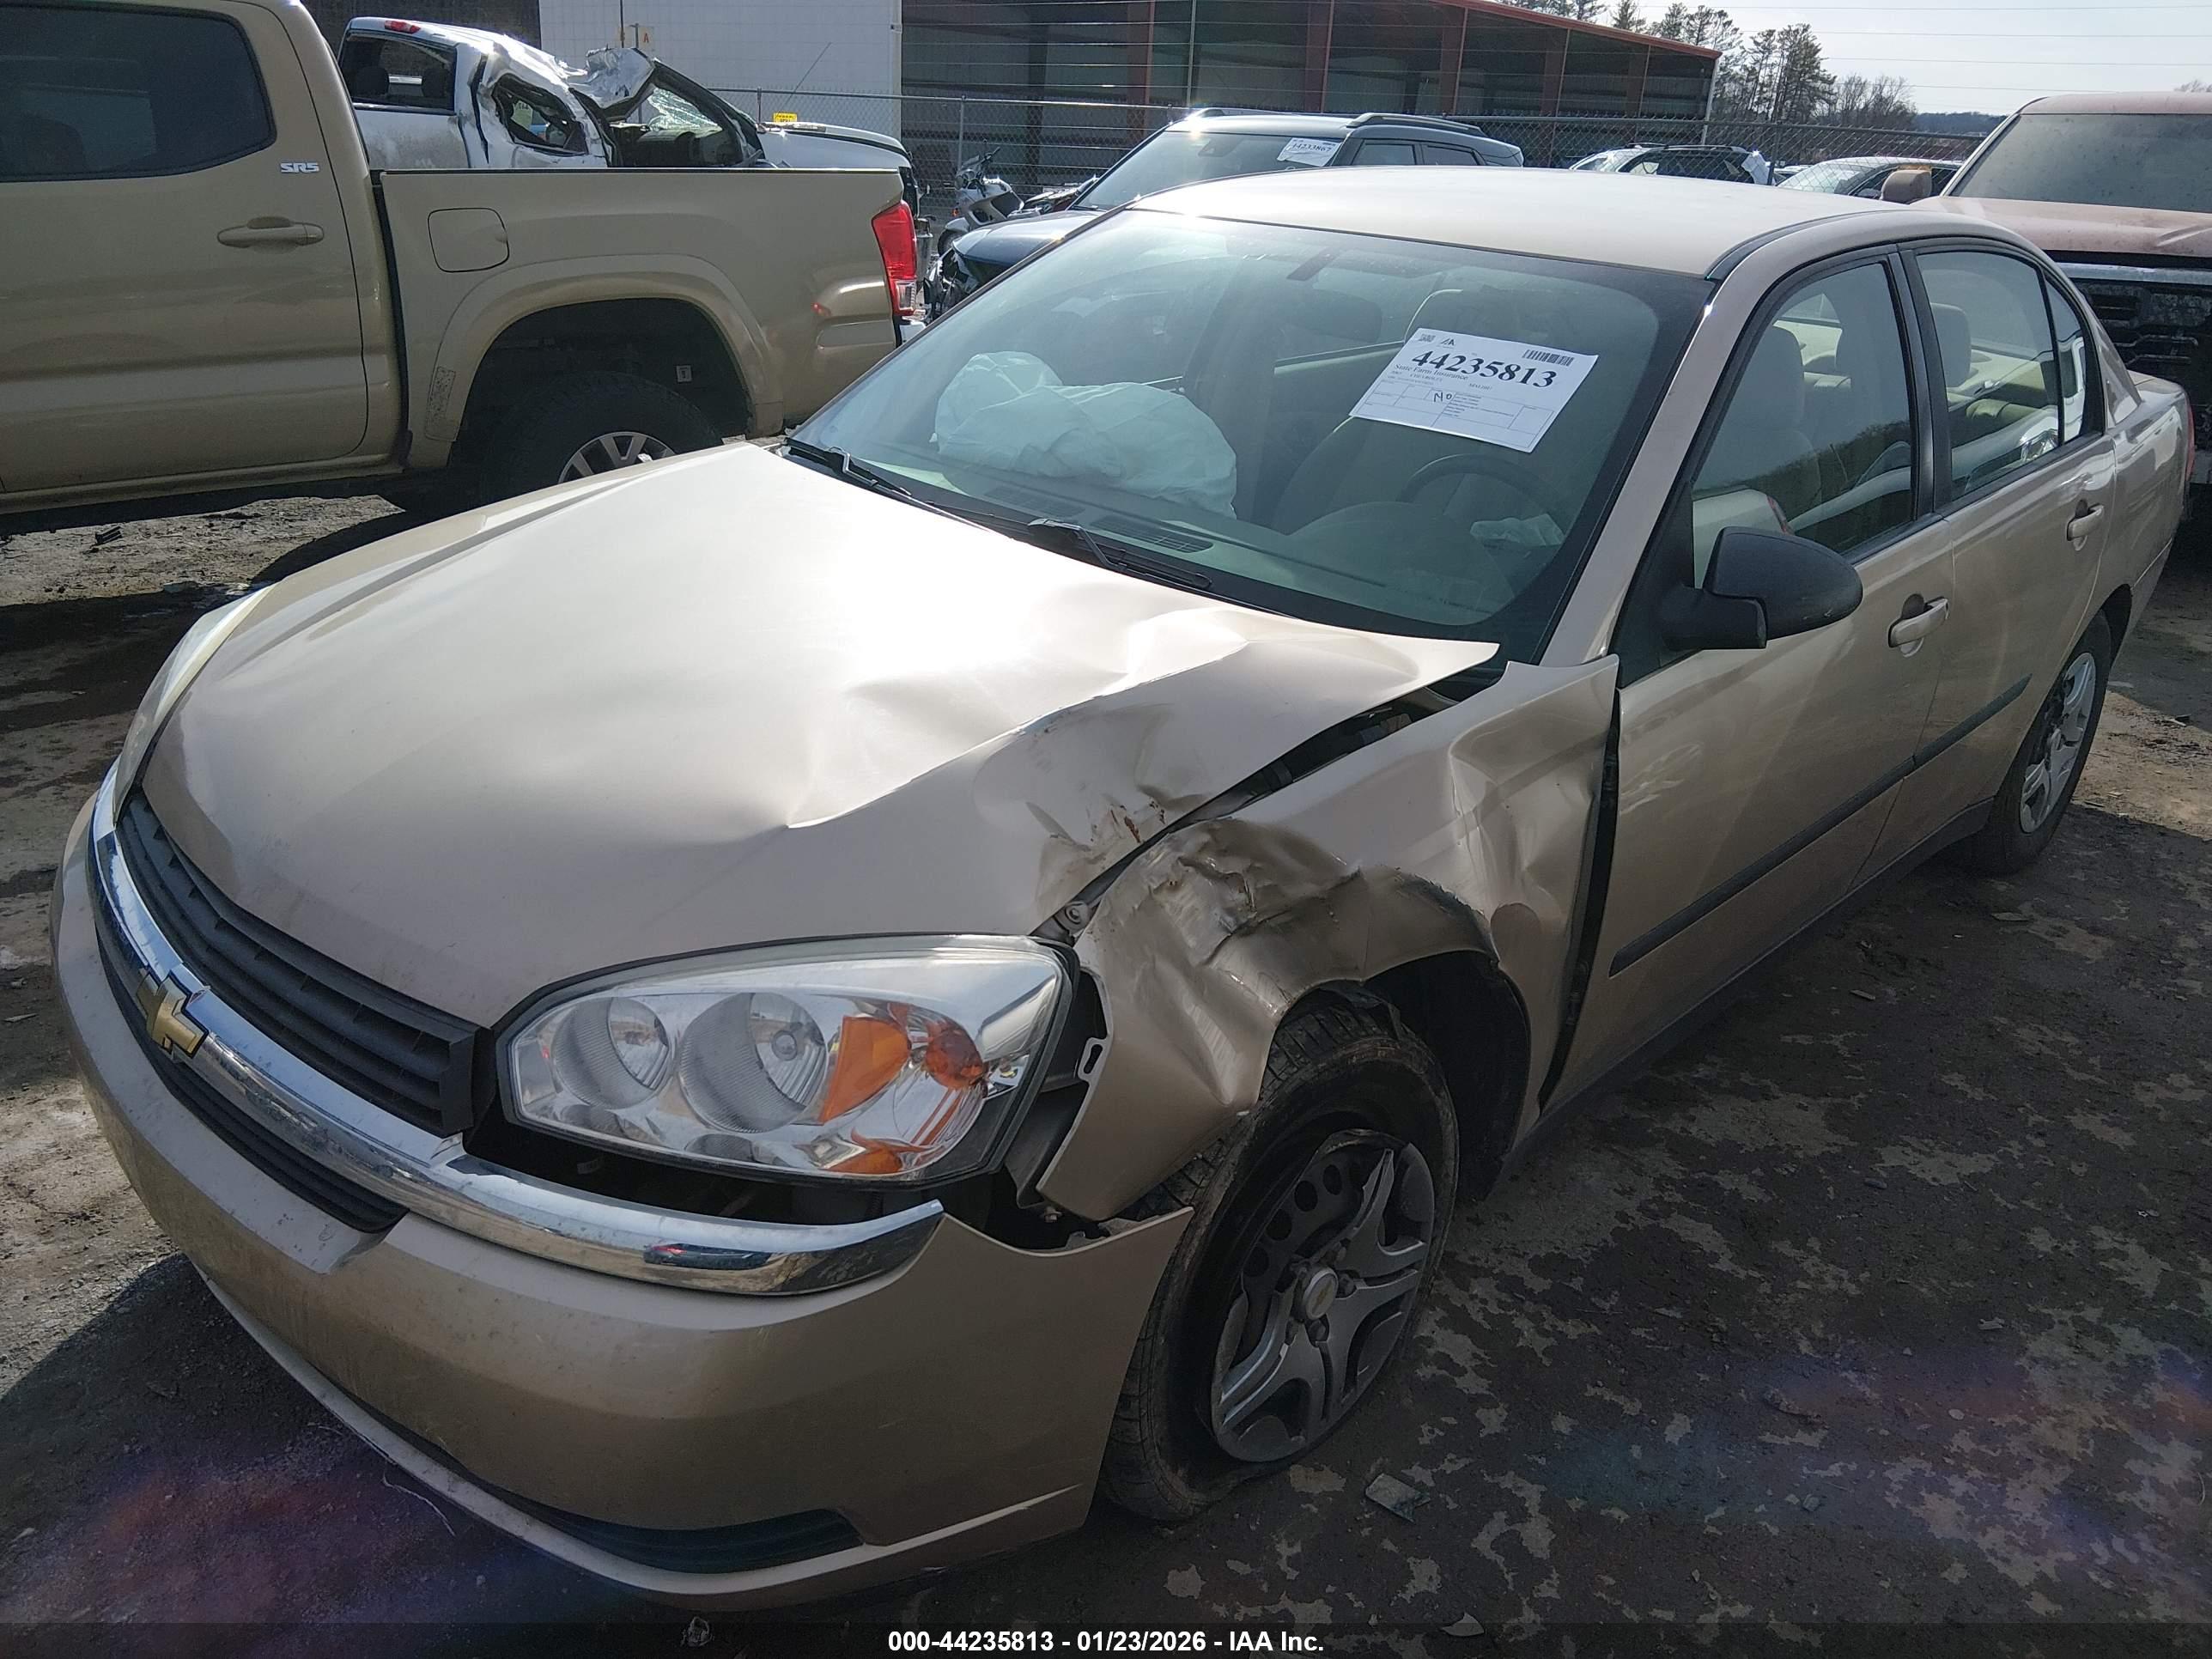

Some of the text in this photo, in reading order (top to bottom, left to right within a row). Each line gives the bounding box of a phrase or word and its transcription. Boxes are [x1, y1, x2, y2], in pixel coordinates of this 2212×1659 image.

[280, 162, 319, 173] SR5
[1412, 350, 1559, 388] 44235813
[1413, 367, 1432, 375] Farm
[1433, 369, 1469, 380] Insurance
